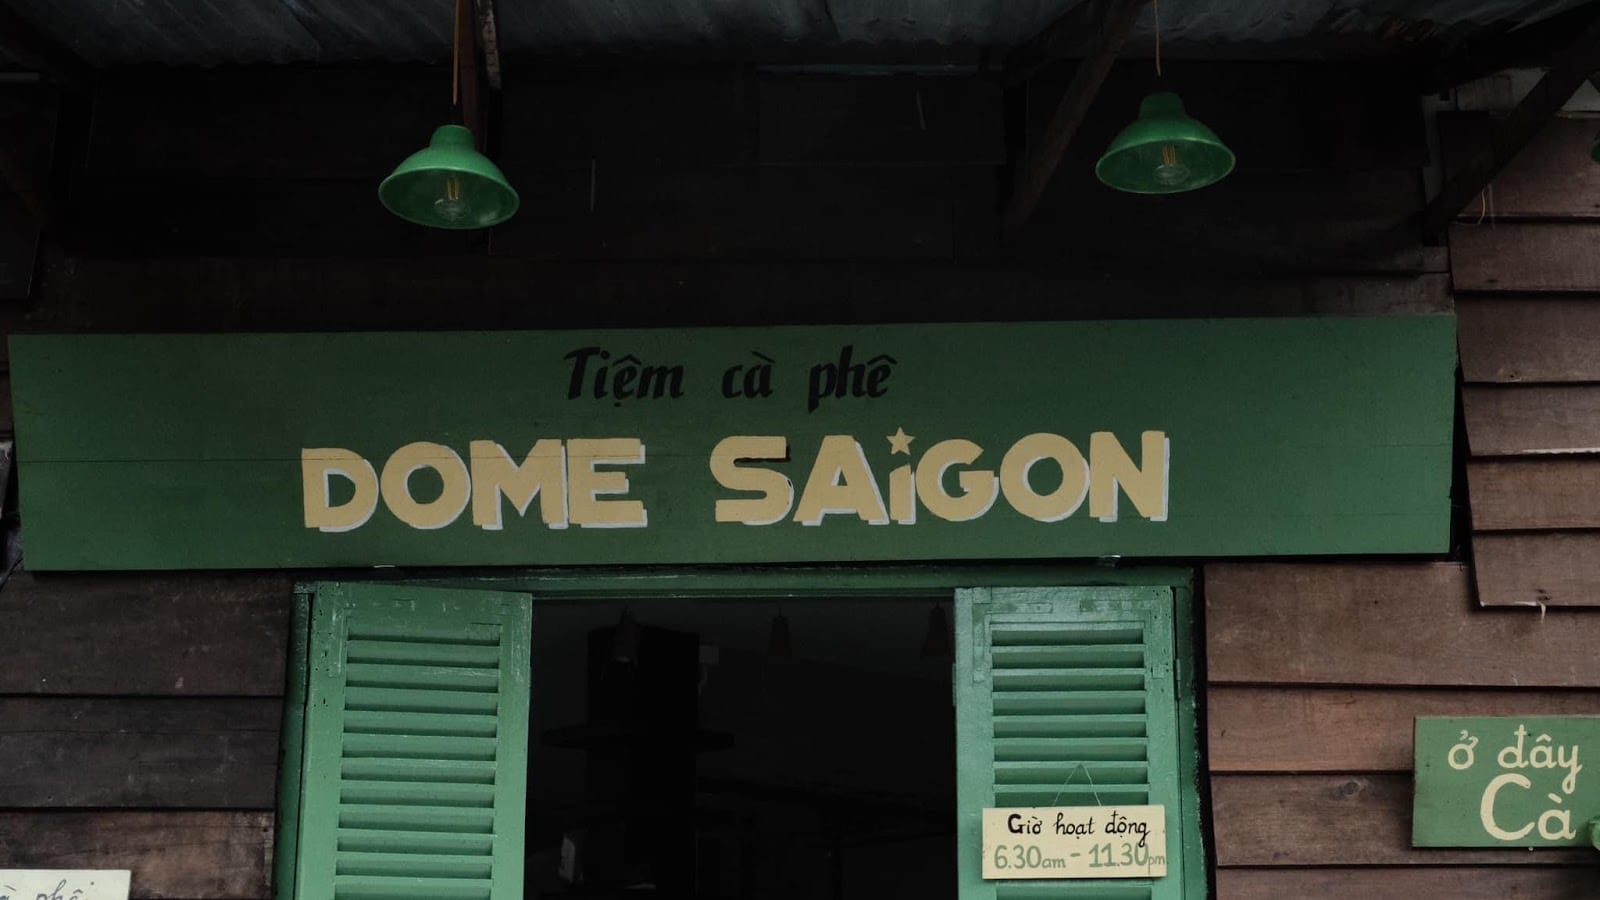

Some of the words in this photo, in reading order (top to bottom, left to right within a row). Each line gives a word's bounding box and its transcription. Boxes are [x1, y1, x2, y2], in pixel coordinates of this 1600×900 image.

[563, 346, 685, 408] Tiệm
[721, 351, 776, 399] cà
[808, 344, 898, 413] phê
[301, 437, 648, 532] DOME
[1447, 729, 1480, 770] ở
[1497, 724, 1583, 794] đây
[1007, 813, 1043, 835] Giờ
[1053, 812, 1095, 840] hoạt
[1104, 810, 1151, 847] động
[1480, 773, 1577, 841] Cà
[993, 844, 1066, 870] 6.30am
[1088, 842, 1166, 876] 11.30pm
